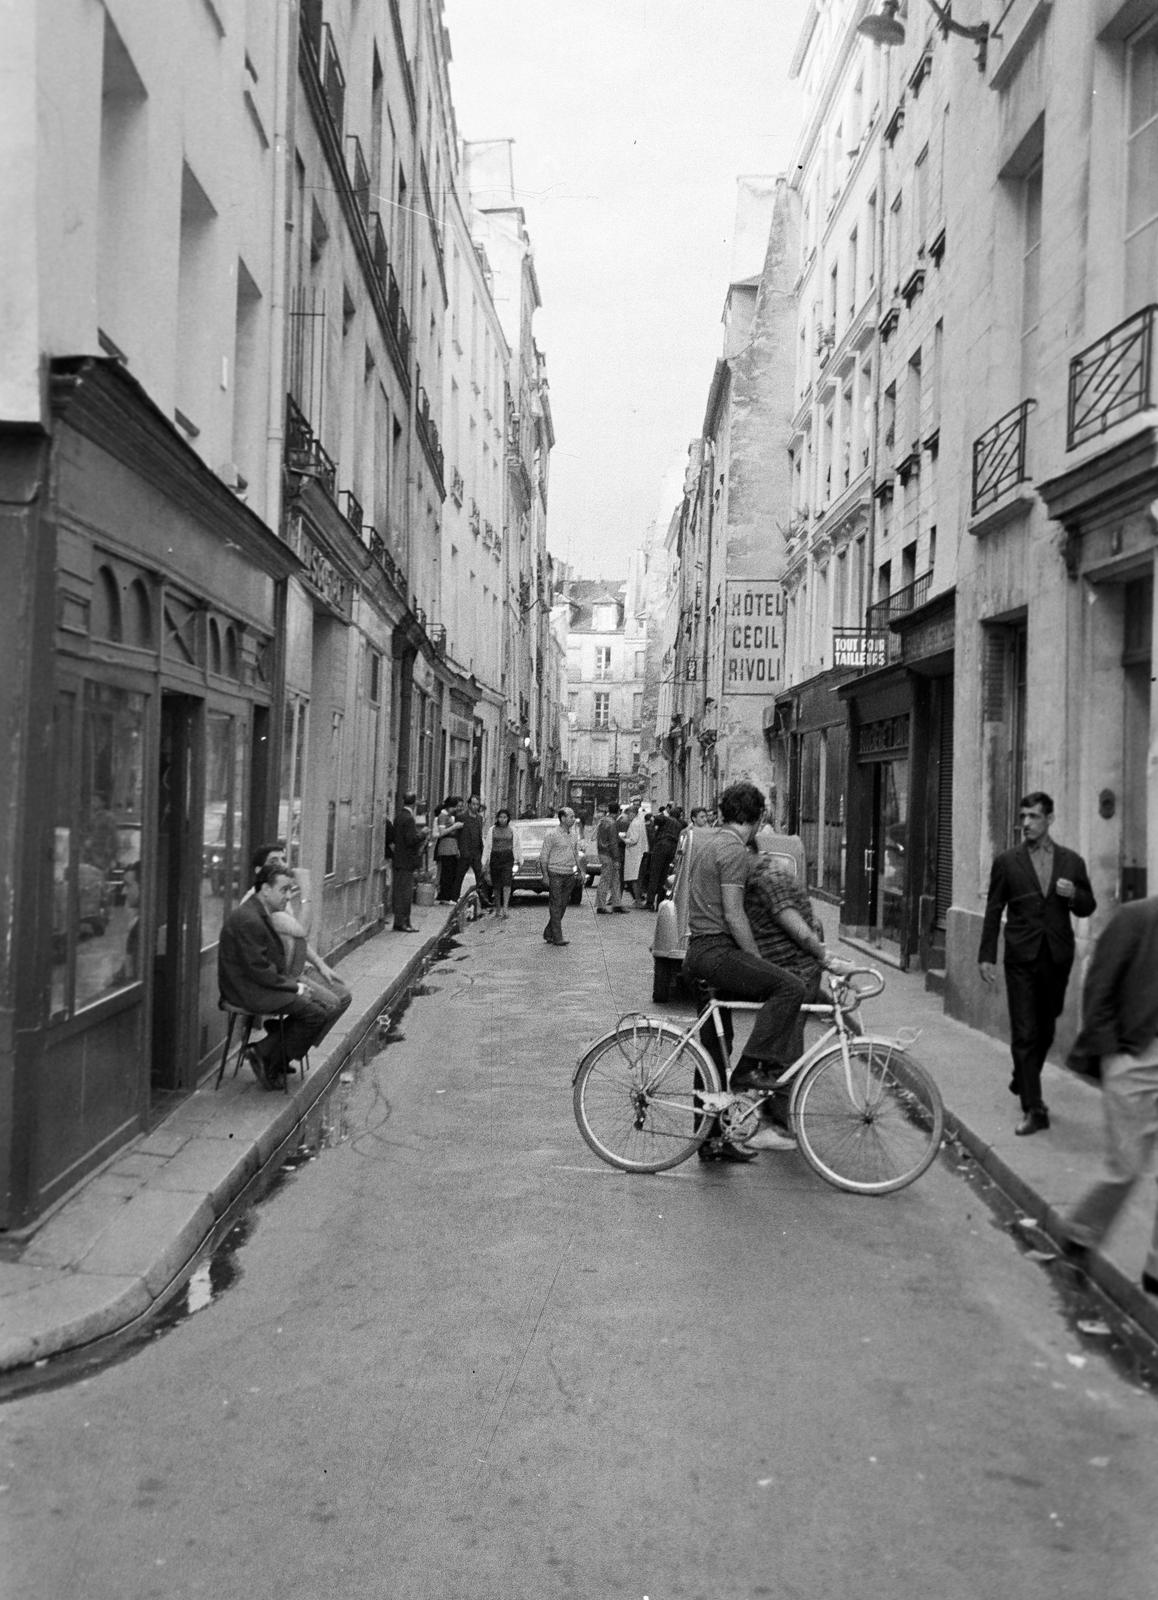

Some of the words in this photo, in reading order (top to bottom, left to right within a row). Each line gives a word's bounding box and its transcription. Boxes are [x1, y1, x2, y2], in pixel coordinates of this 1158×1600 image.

[834, 638, 858, 651] TOUT
[834, 651, 886, 666] TAILLEURS
[729, 658, 780, 681] RIVOLI
